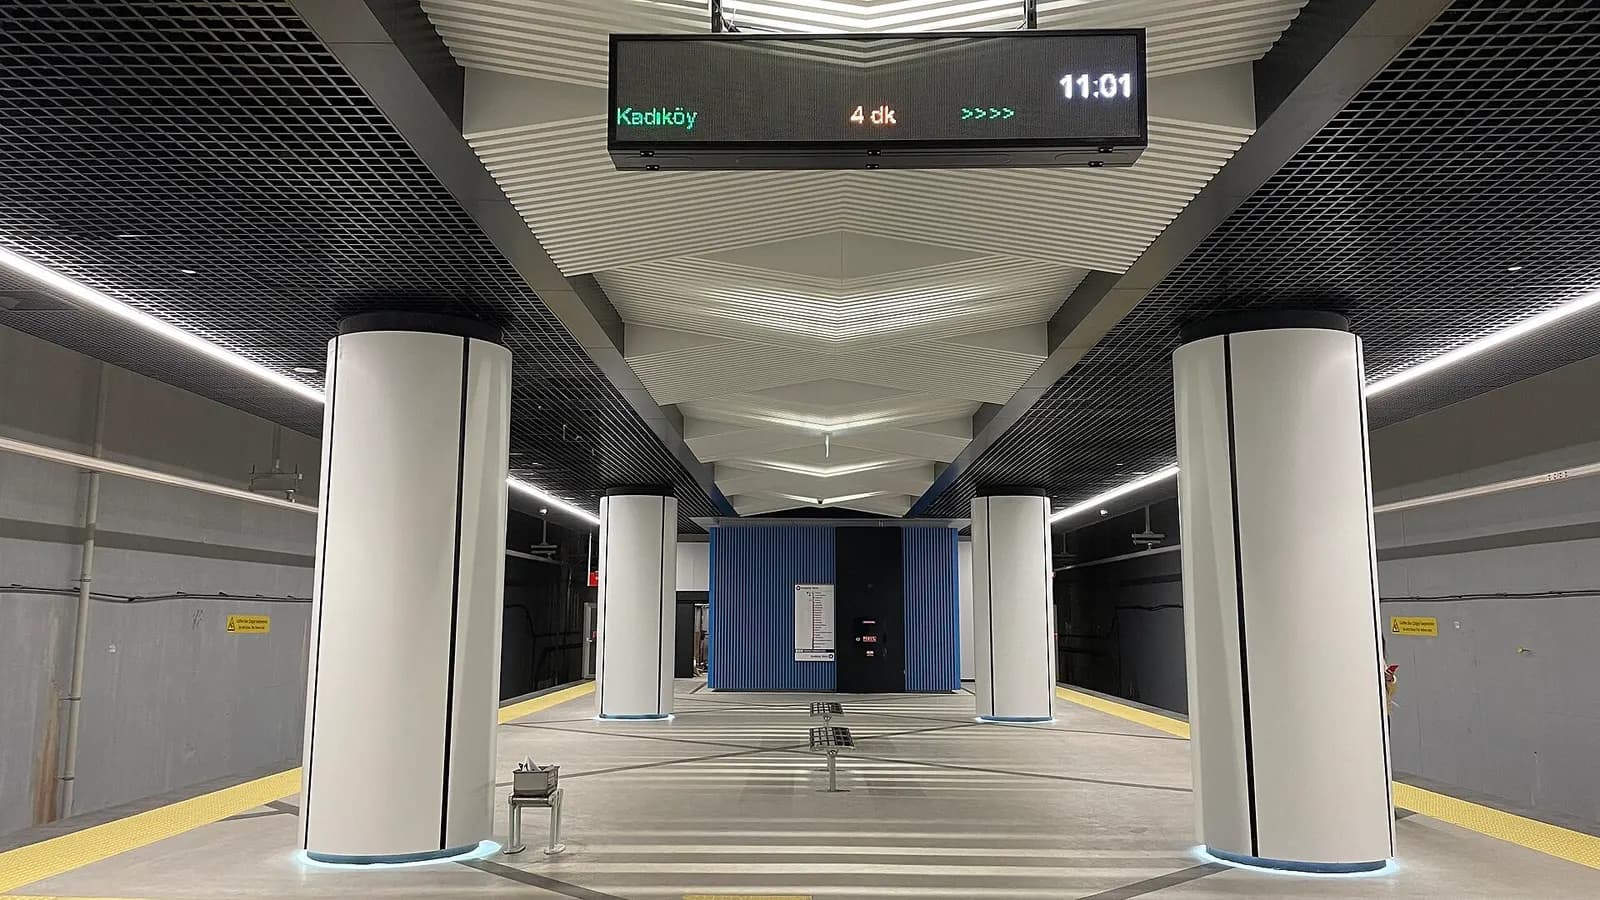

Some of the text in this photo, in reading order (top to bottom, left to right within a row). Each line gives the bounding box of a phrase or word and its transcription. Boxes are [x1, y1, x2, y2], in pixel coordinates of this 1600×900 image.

[1058, 72, 1131, 99] 11:01
[616, 107, 698, 130] Kadıköy
[850, 105, 897, 124] 4 dk
